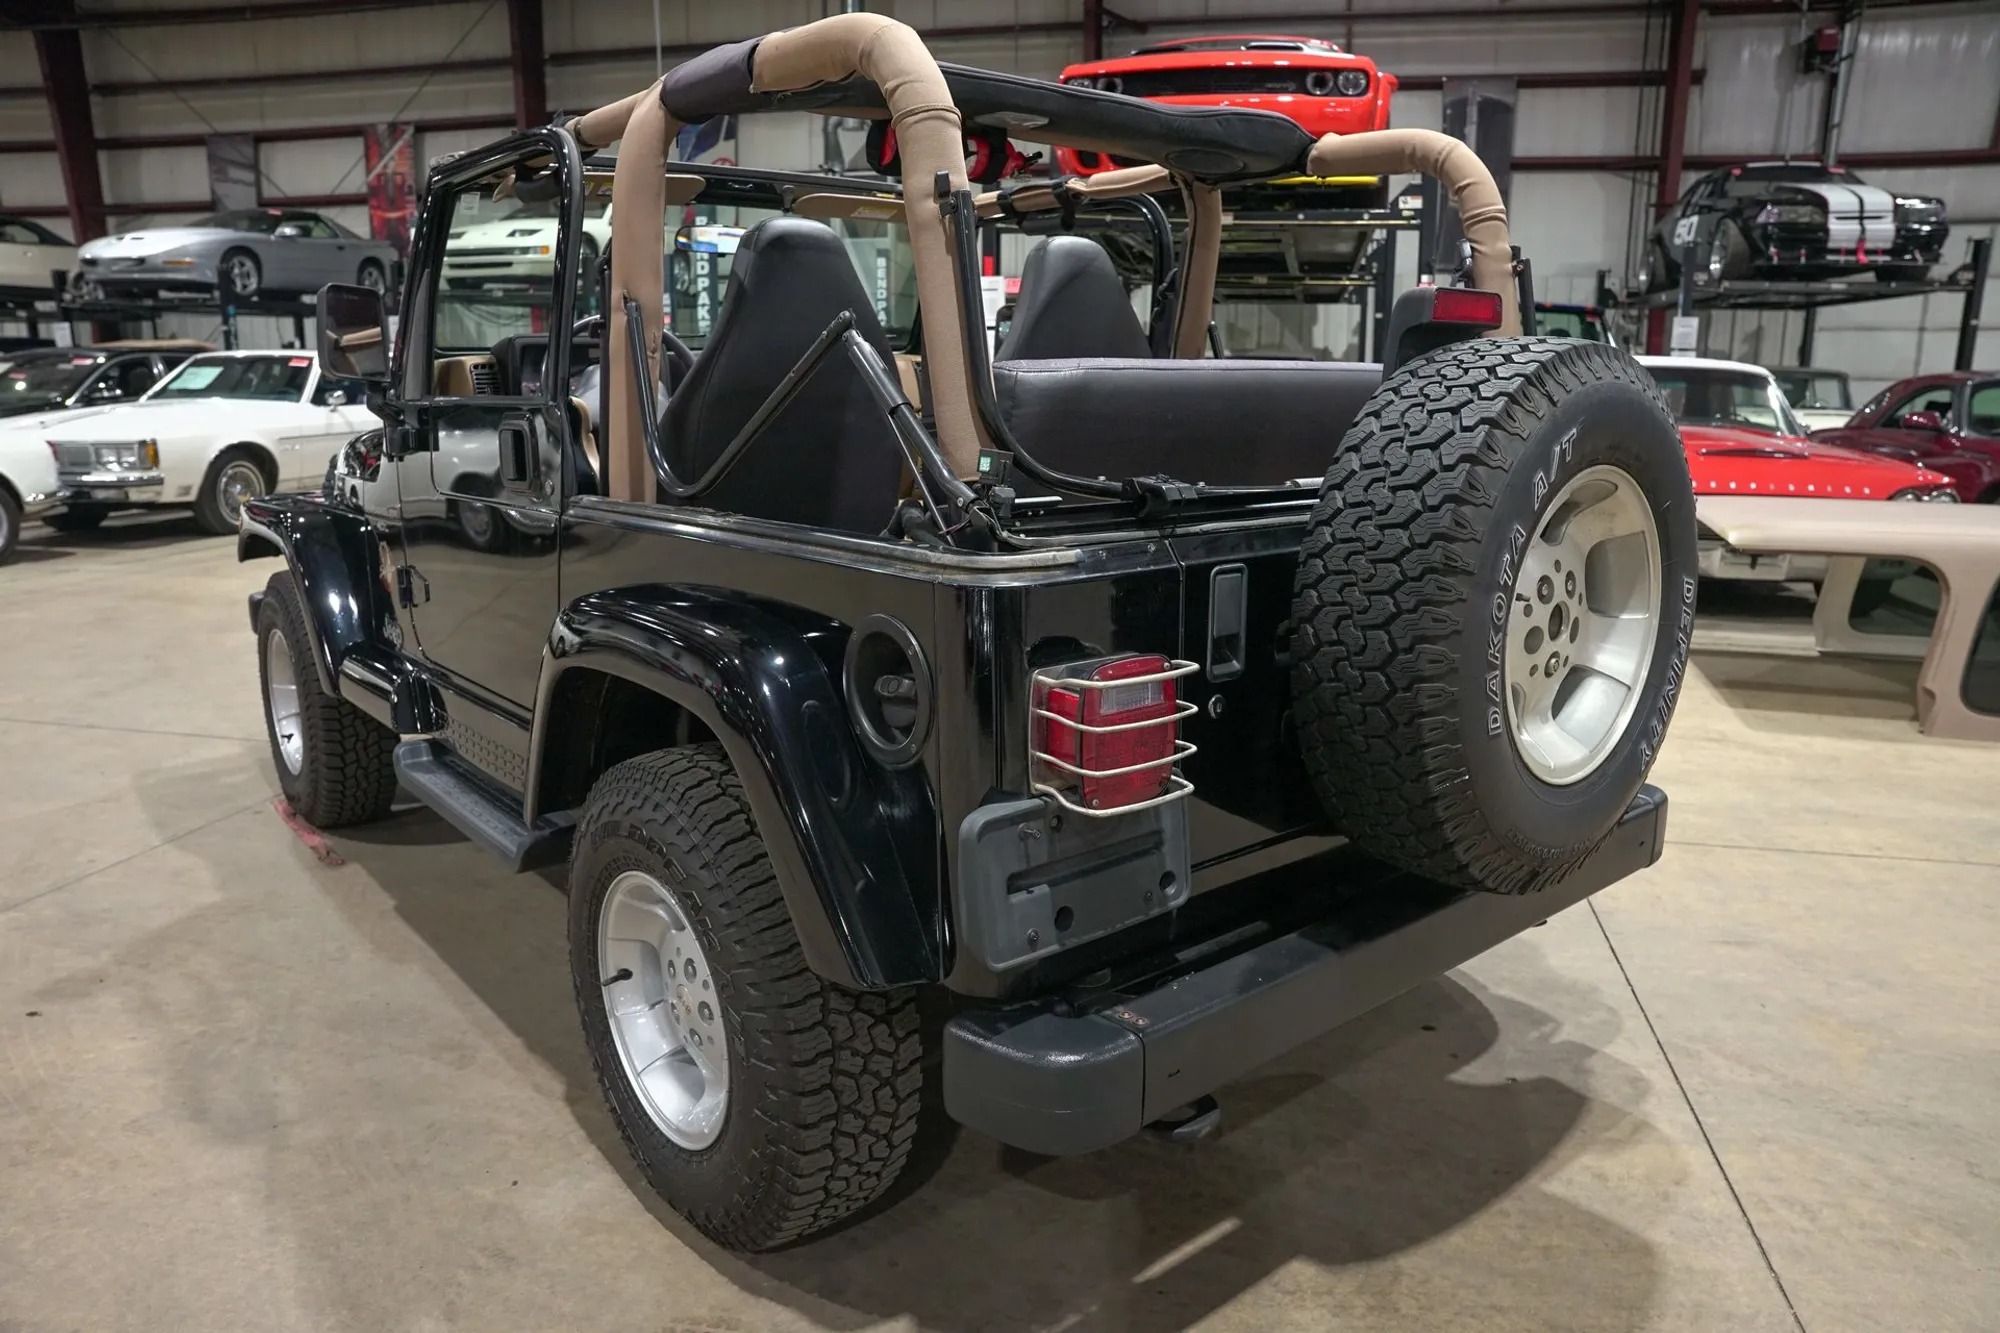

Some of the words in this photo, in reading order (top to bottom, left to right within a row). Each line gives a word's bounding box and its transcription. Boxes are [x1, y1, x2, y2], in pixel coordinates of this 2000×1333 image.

[1485, 524, 1527, 736] DAKOTA
[1533, 427, 1578, 510] A/T
[1639, 576, 1696, 773] DEFINITY
